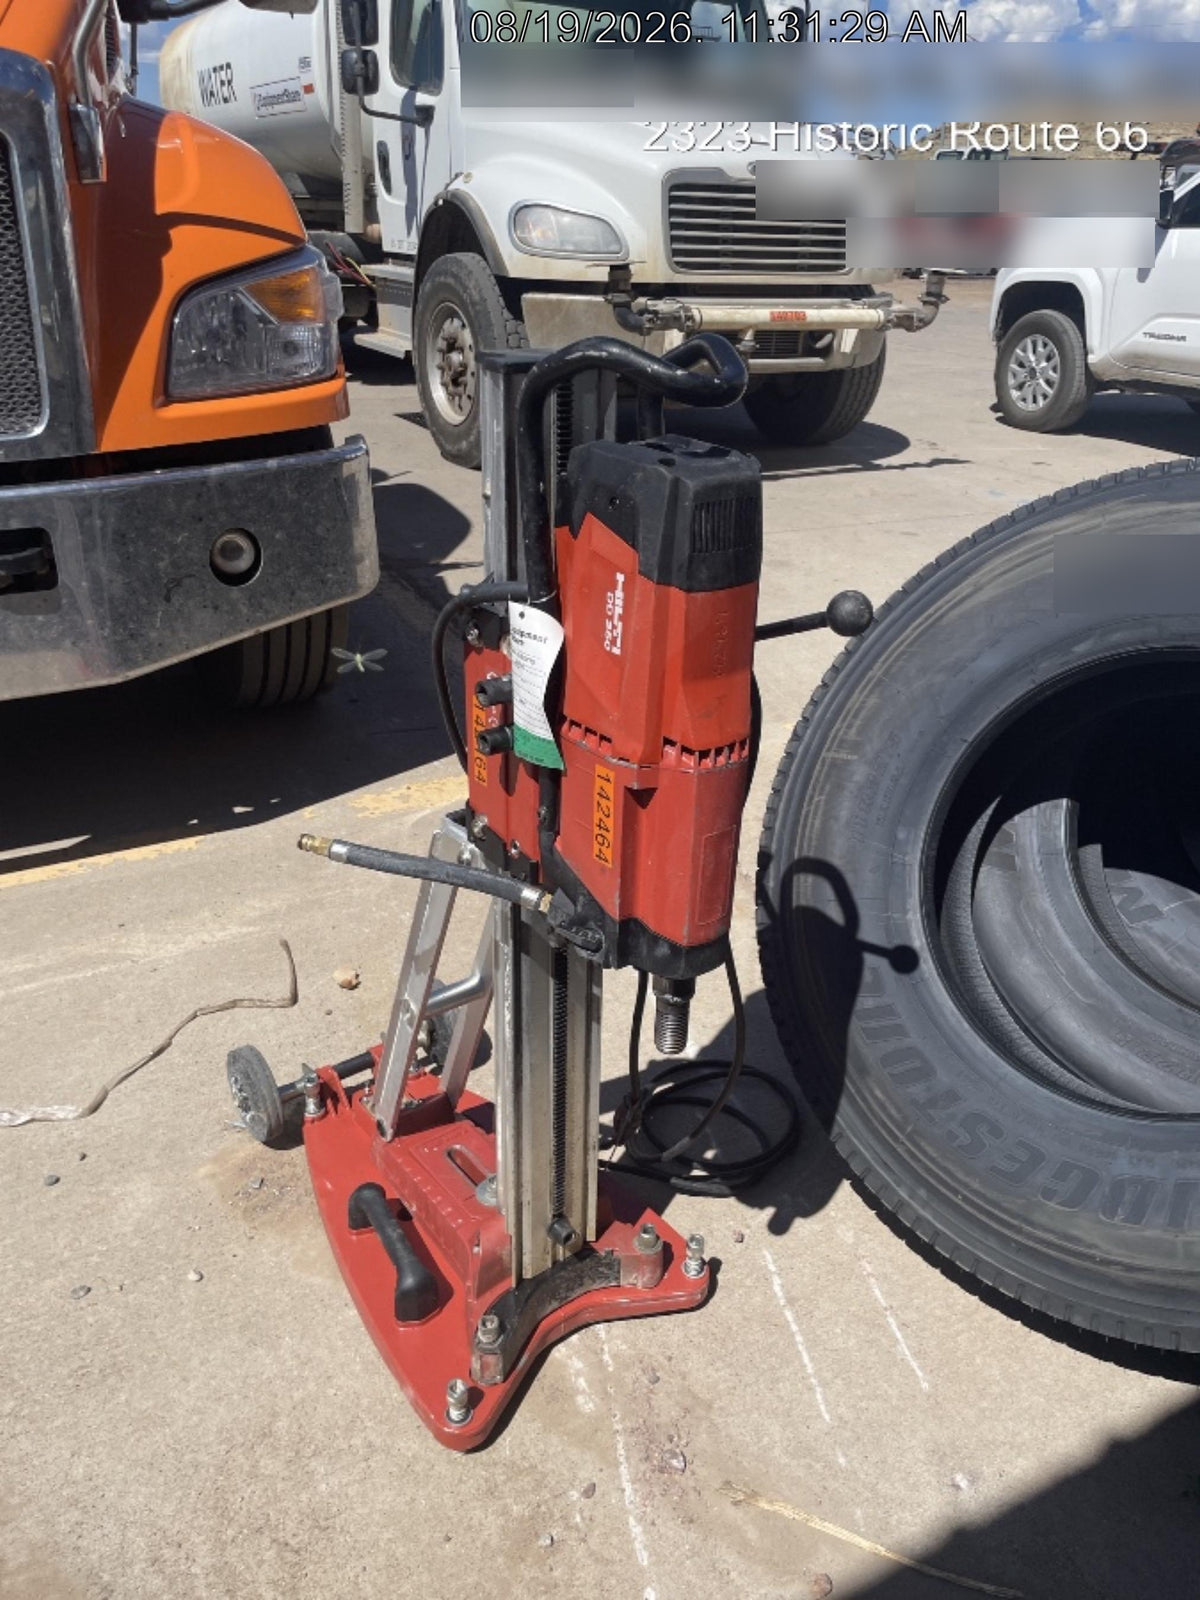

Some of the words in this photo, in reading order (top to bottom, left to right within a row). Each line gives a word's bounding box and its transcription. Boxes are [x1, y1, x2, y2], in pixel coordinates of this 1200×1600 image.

[197, 62, 238, 107] WATER
[606, 591, 614, 616] DD
[611, 571, 625, 656] HILTI
[474, 702, 486, 785] 1464
[594, 772, 612, 864] 142464
